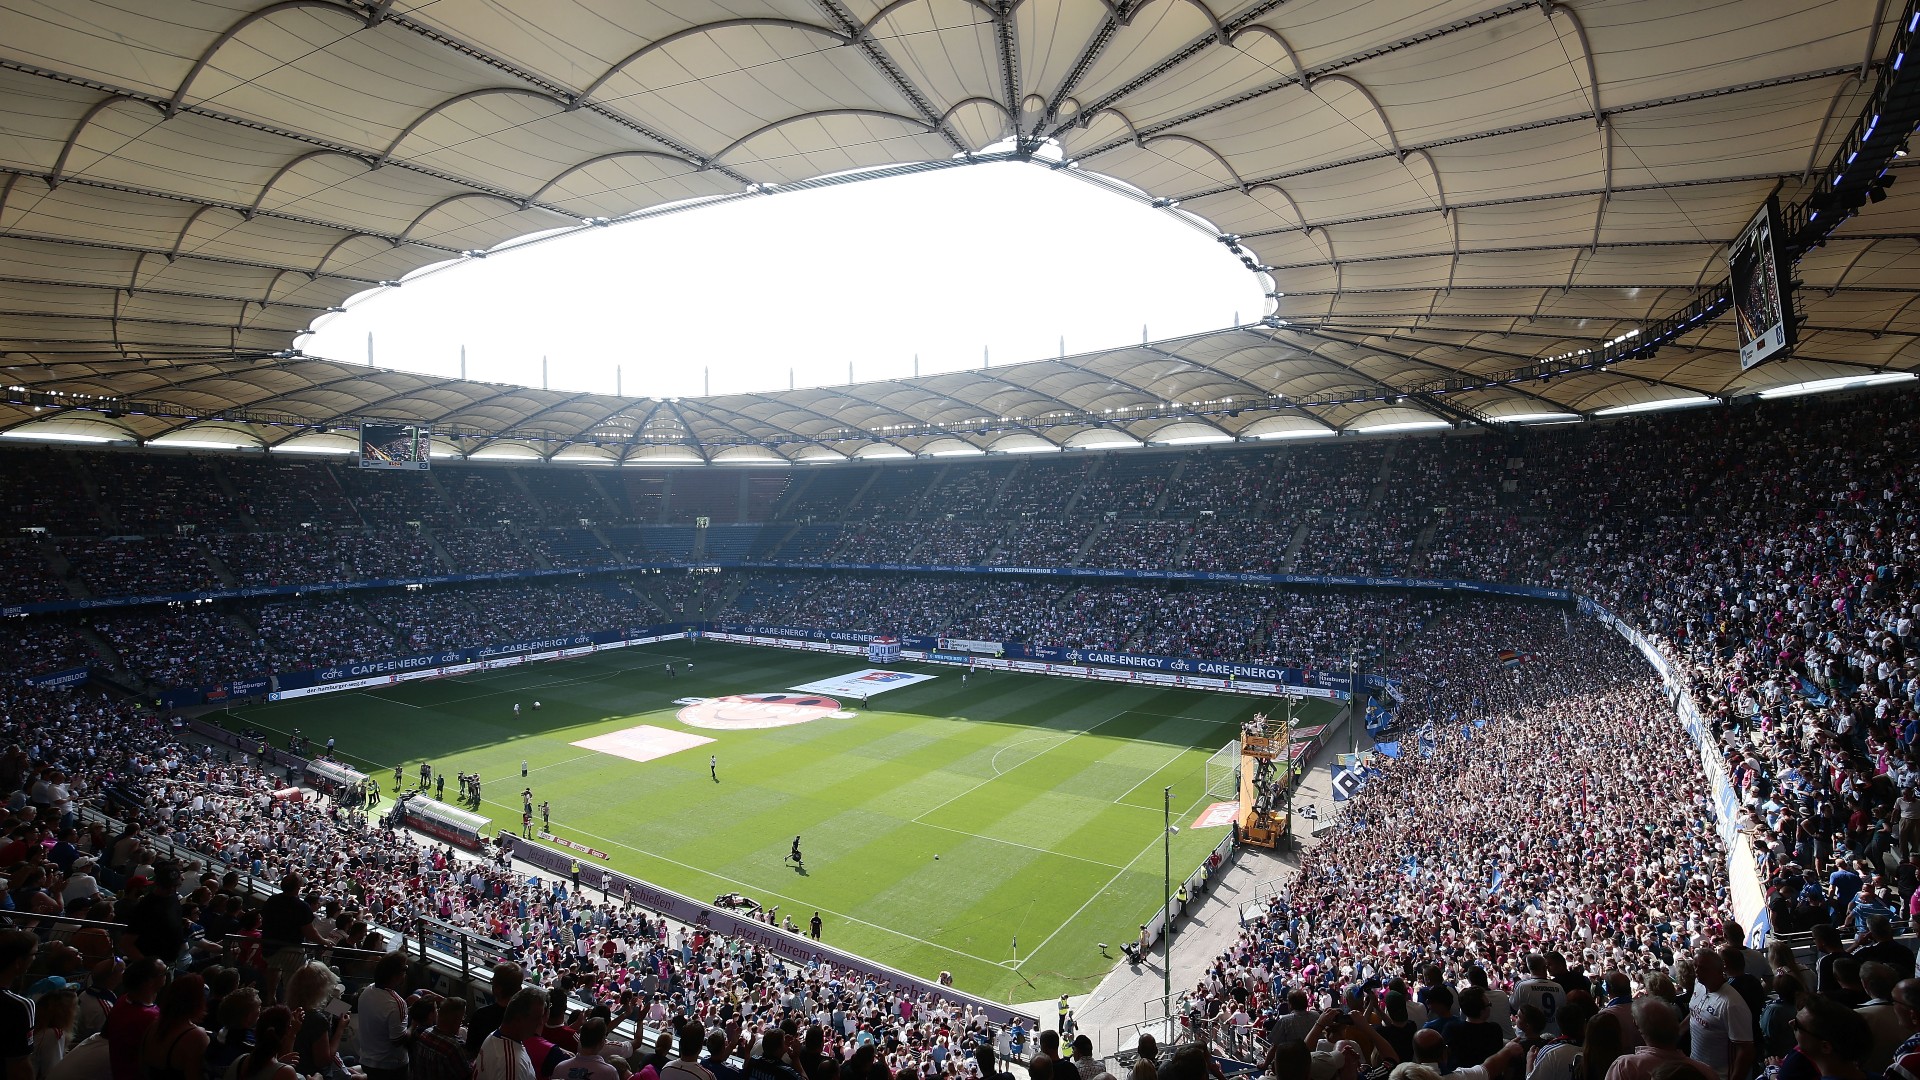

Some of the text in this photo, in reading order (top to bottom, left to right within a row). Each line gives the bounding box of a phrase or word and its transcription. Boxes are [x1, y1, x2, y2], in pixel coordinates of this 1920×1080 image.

[760, 627, 809, 637] CARE-ENERGY
[831, 632, 881, 642] CARE-ENERG
[502, 637, 569, 652] CARE-ENERGY
[1088, 652, 1163, 668] CARE-ENERGY
[1198, 662, 1285, 680] CARE-ENERGY
[527, 849, 545, 863] Jetzt
[546, 854, 555, 866] in
[732, 923, 757, 940] Jetzt
[759, 932, 771, 947] in
[775, 938, 811, 961] Ihrem
[1541, 992, 1556, 1018] 9
